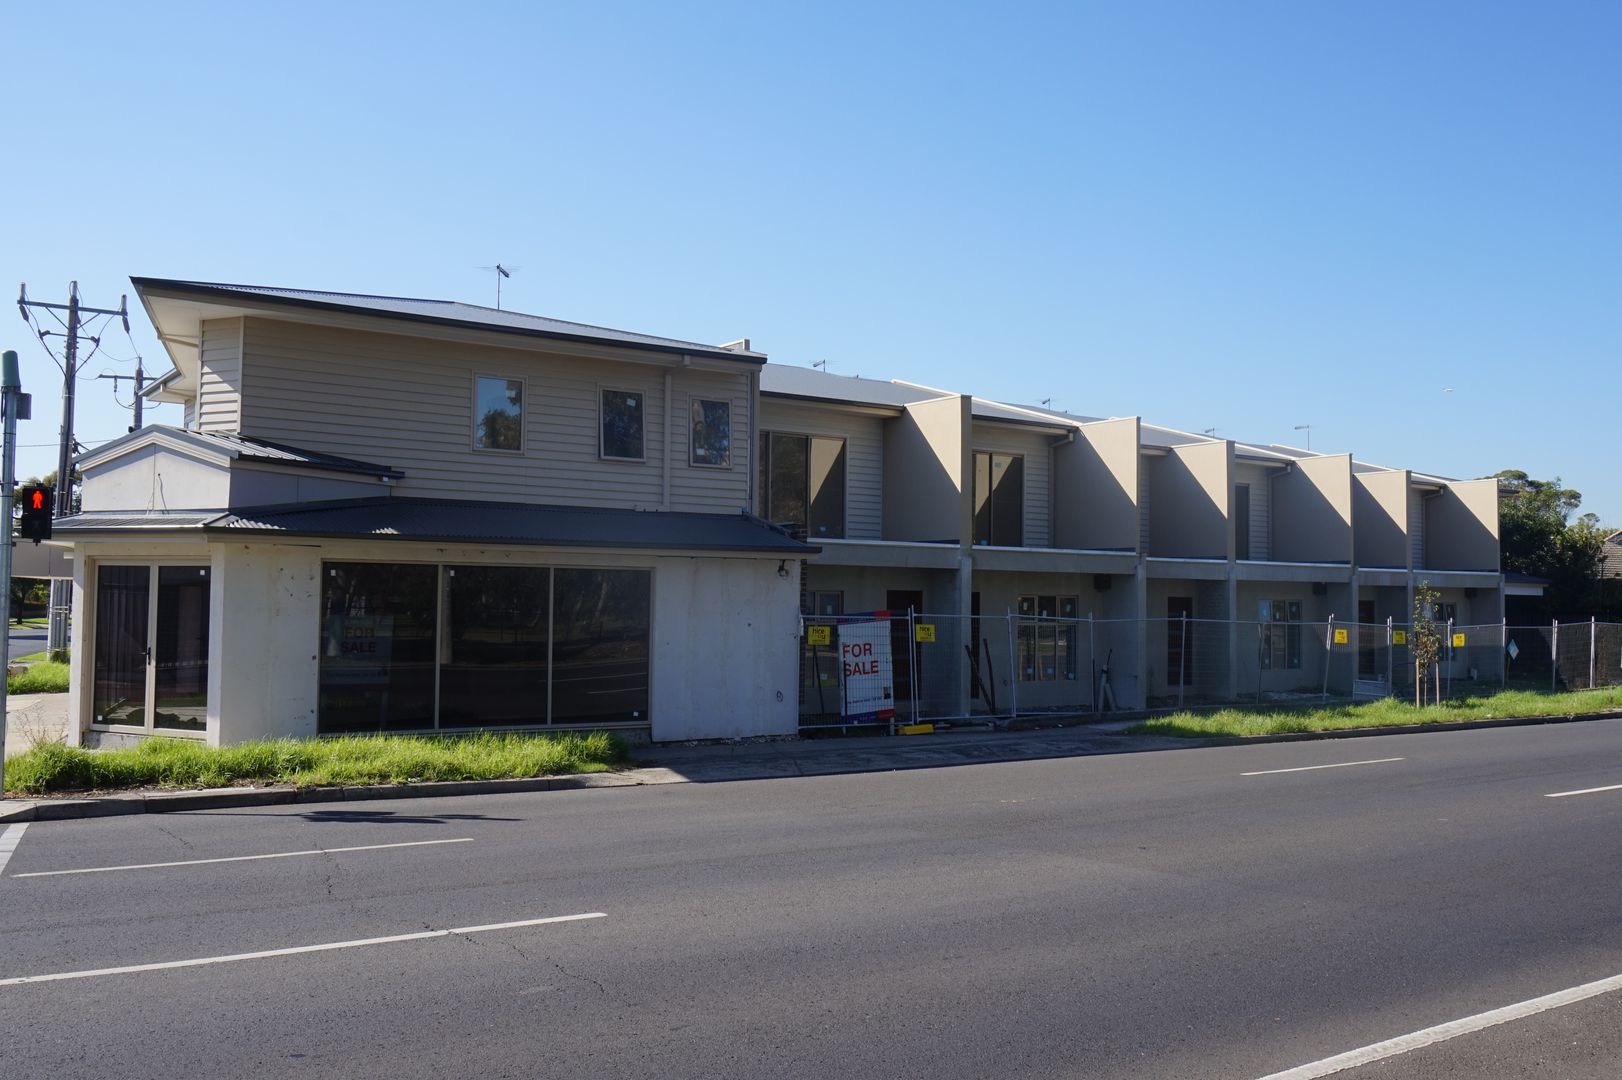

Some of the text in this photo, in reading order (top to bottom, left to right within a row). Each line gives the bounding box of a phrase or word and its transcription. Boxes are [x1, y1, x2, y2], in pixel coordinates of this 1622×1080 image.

[344, 628, 374, 638] FOR
[342, 641, 376, 652] SALE
[842, 643, 872, 658] FOR
[845, 661, 879, 677] SALE
